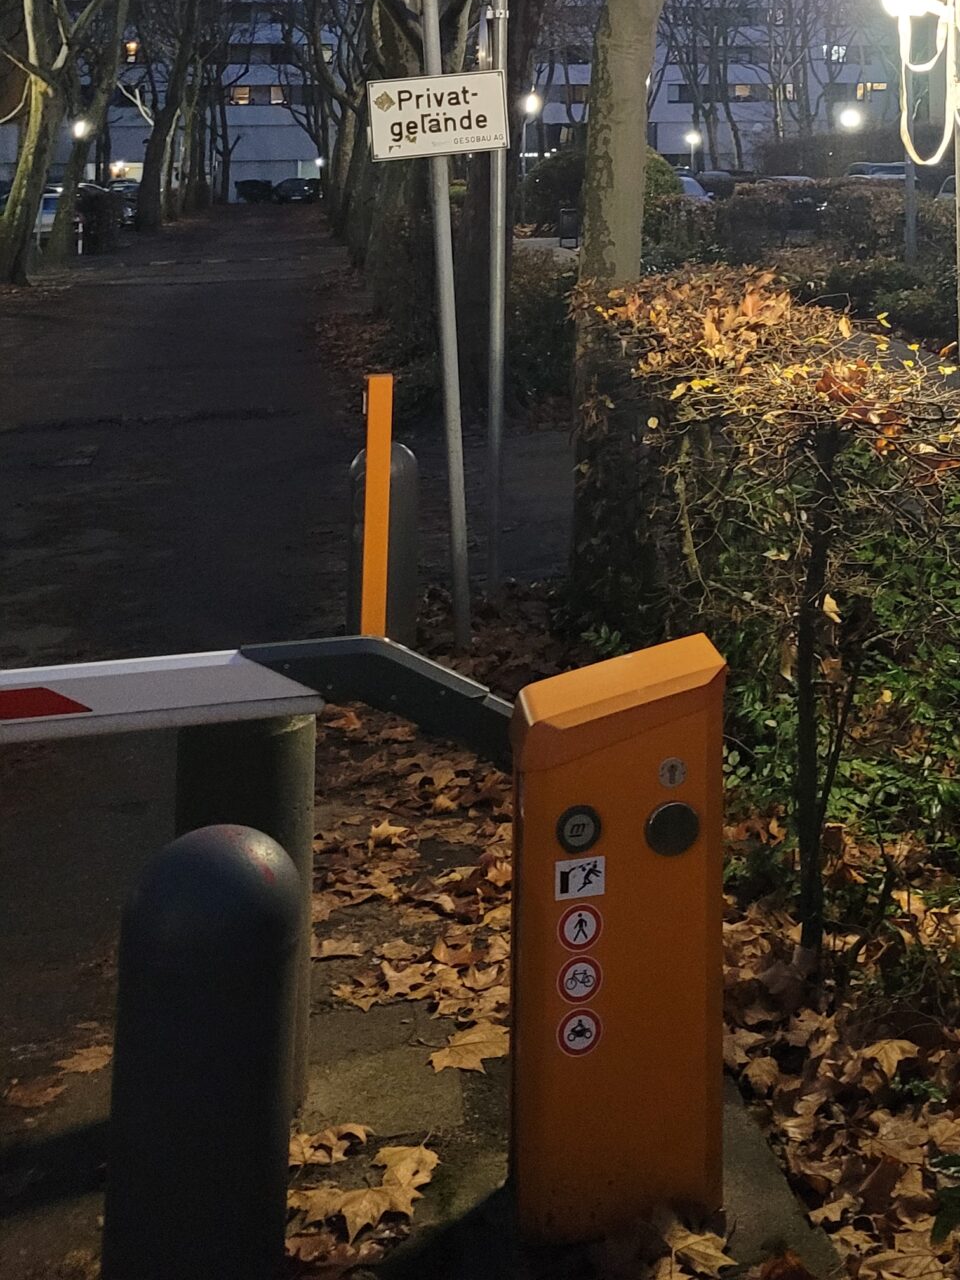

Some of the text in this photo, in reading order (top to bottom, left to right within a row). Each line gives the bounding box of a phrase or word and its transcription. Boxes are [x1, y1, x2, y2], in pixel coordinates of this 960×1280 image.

[397, 86, 478, 111] Privat-
[390, 110, 488, 142] gelände
[453, 136, 492, 145] GESOBAU
[493, 133, 504, 141] AG
